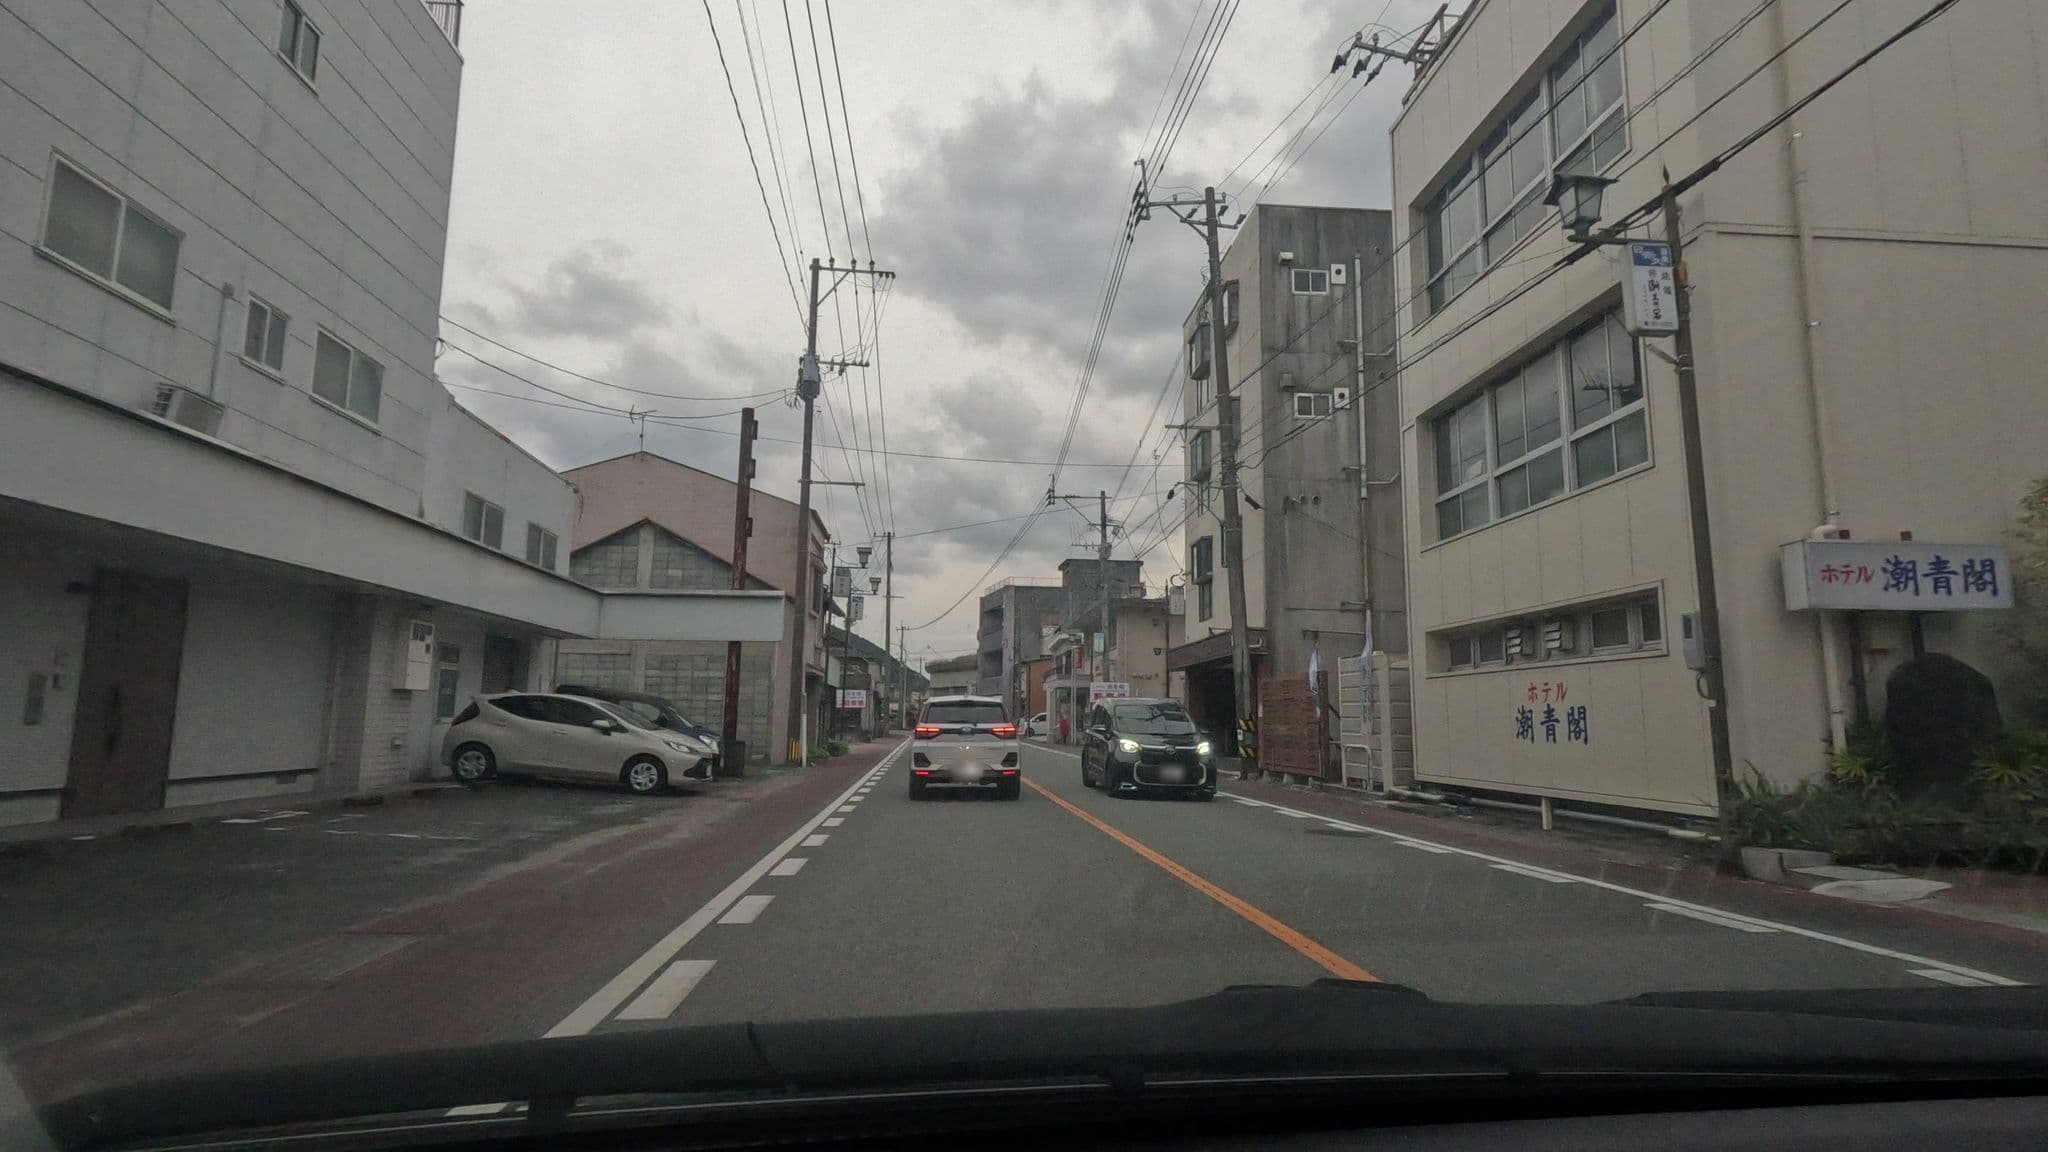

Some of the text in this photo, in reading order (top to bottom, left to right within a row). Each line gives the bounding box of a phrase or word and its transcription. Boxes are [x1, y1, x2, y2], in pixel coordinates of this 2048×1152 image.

[1821, 555, 1999, 597] ホテル 潮青閣
[1528, 682, 1568, 702] ホテル
[1516, 703, 1588, 745] 潮青閣
